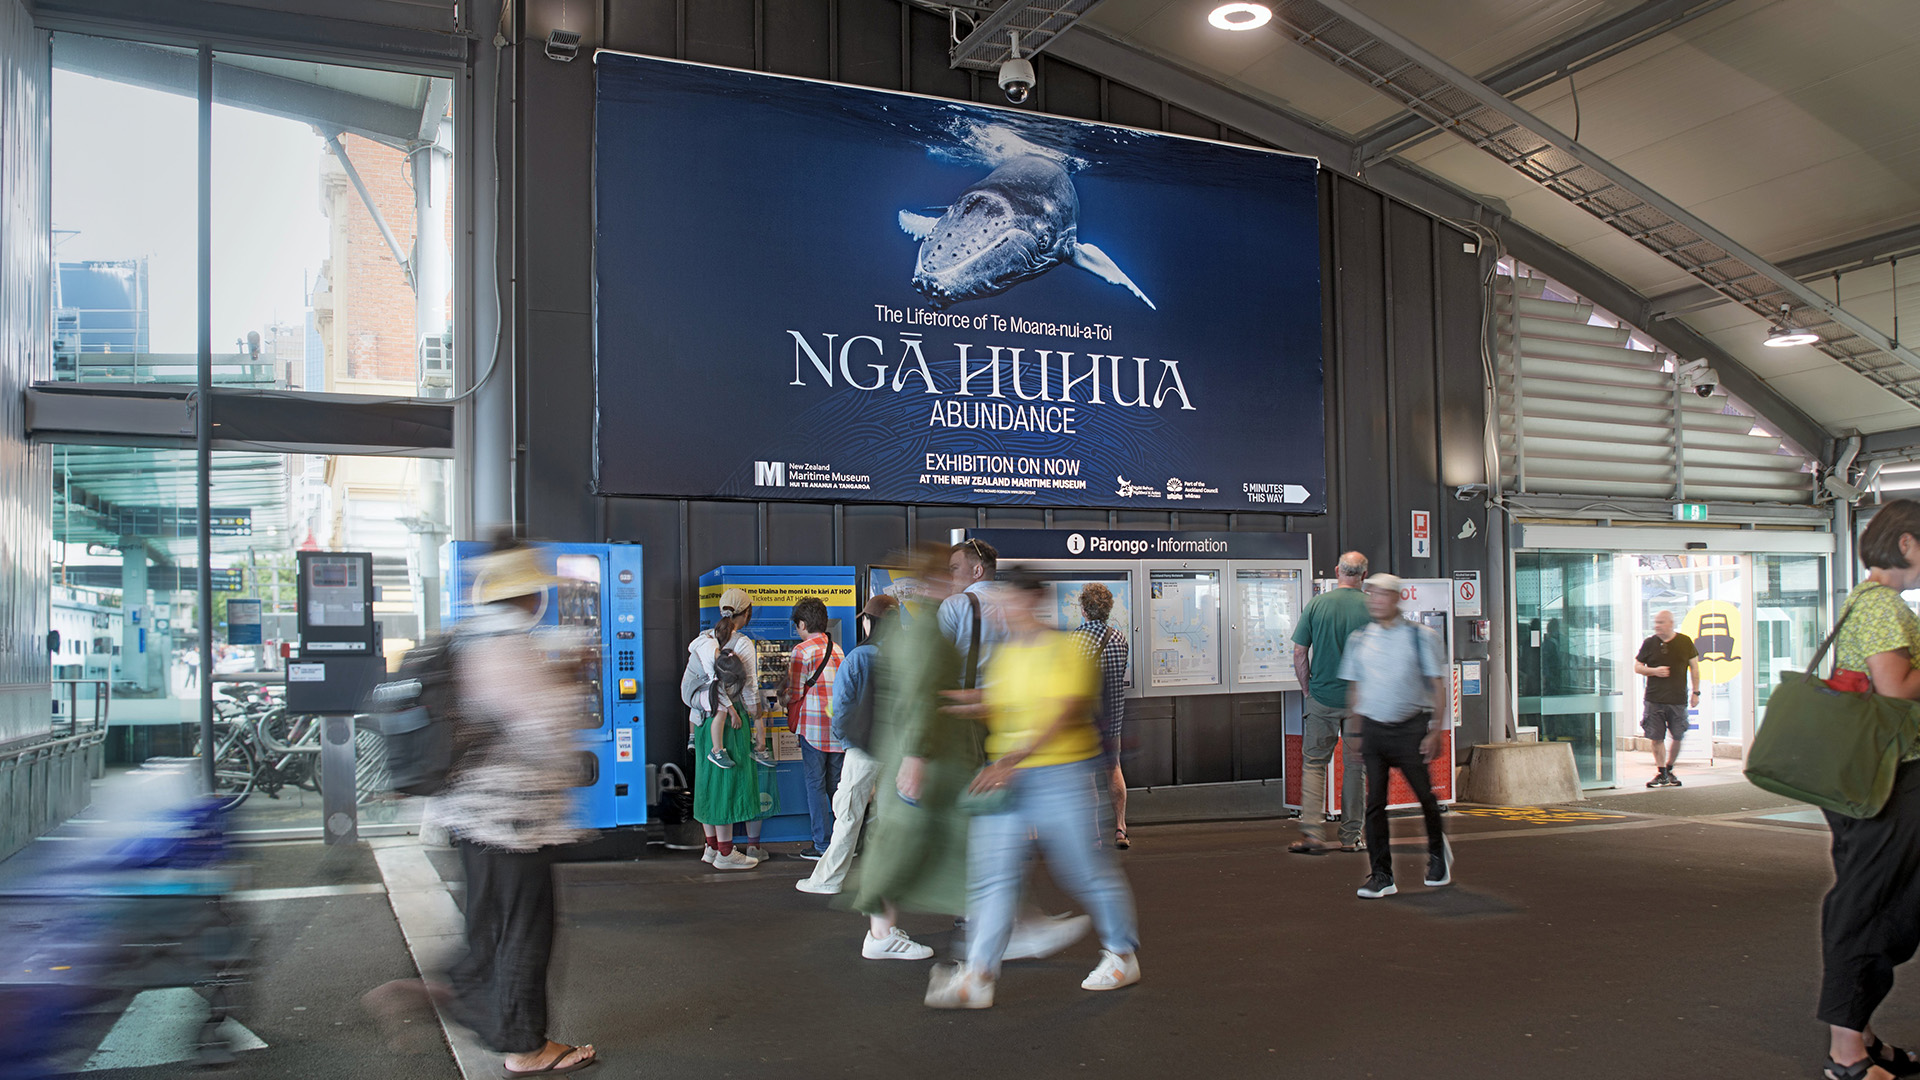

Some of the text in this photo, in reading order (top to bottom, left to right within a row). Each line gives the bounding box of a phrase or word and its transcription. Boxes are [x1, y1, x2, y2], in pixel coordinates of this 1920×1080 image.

[874, 304, 903, 323] The
[973, 313, 988, 330] of
[990, 314, 1008, 332] Te
[1010, 316, 1112, 341] Moana-nui-a-Toi
[786, 329, 1197, 411] NGĀ HUHUA
[929, 400, 1076, 434] ABUNDANCE
[804, 463, 830, 471] Zealand
[925, 453, 1081, 476] EXHIBITION ON NOW
[789, 471, 870, 483] Maritime Museum
[919, 474, 1087, 490] AT THE NEW ZEALAND MARITIME MUSEUM
[1242, 482, 1284, 494] 5 MINUTES
[1247, 492, 1284, 503] THIS WAY
[1090, 537, 1149, 554] Pārongo
[1157, 537, 1228, 552] Information
